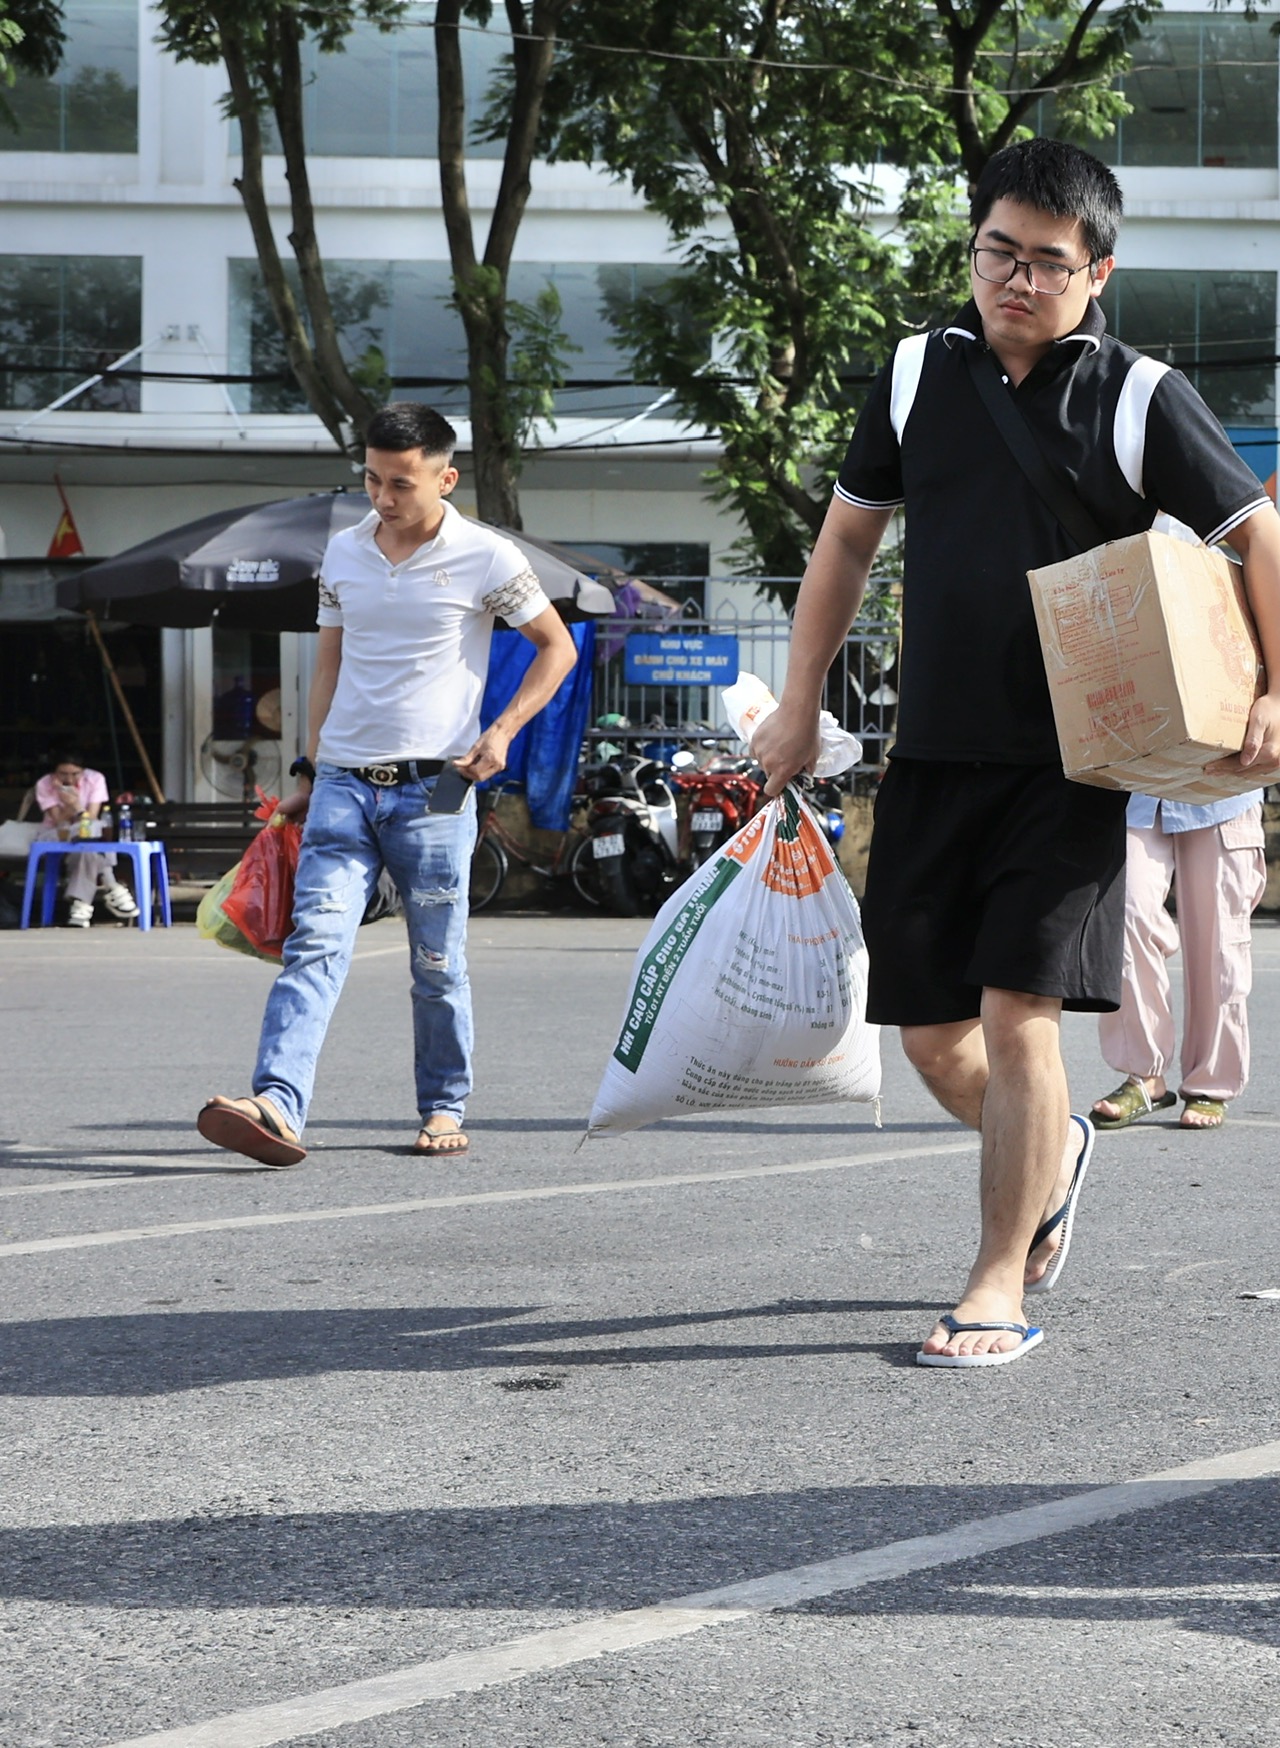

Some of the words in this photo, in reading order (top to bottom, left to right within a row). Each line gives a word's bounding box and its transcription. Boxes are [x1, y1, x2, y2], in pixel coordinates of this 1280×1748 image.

[662, 961, 677, 983] ĐẾN
[655, 982, 666, 998] NT
[620, 1030, 635, 1056] HH
[629, 998, 647, 1031] CAO
[640, 965, 660, 997] CẤP
[651, 998, 660, 1011] 01
[644, 1010, 655, 1025] TỪ
